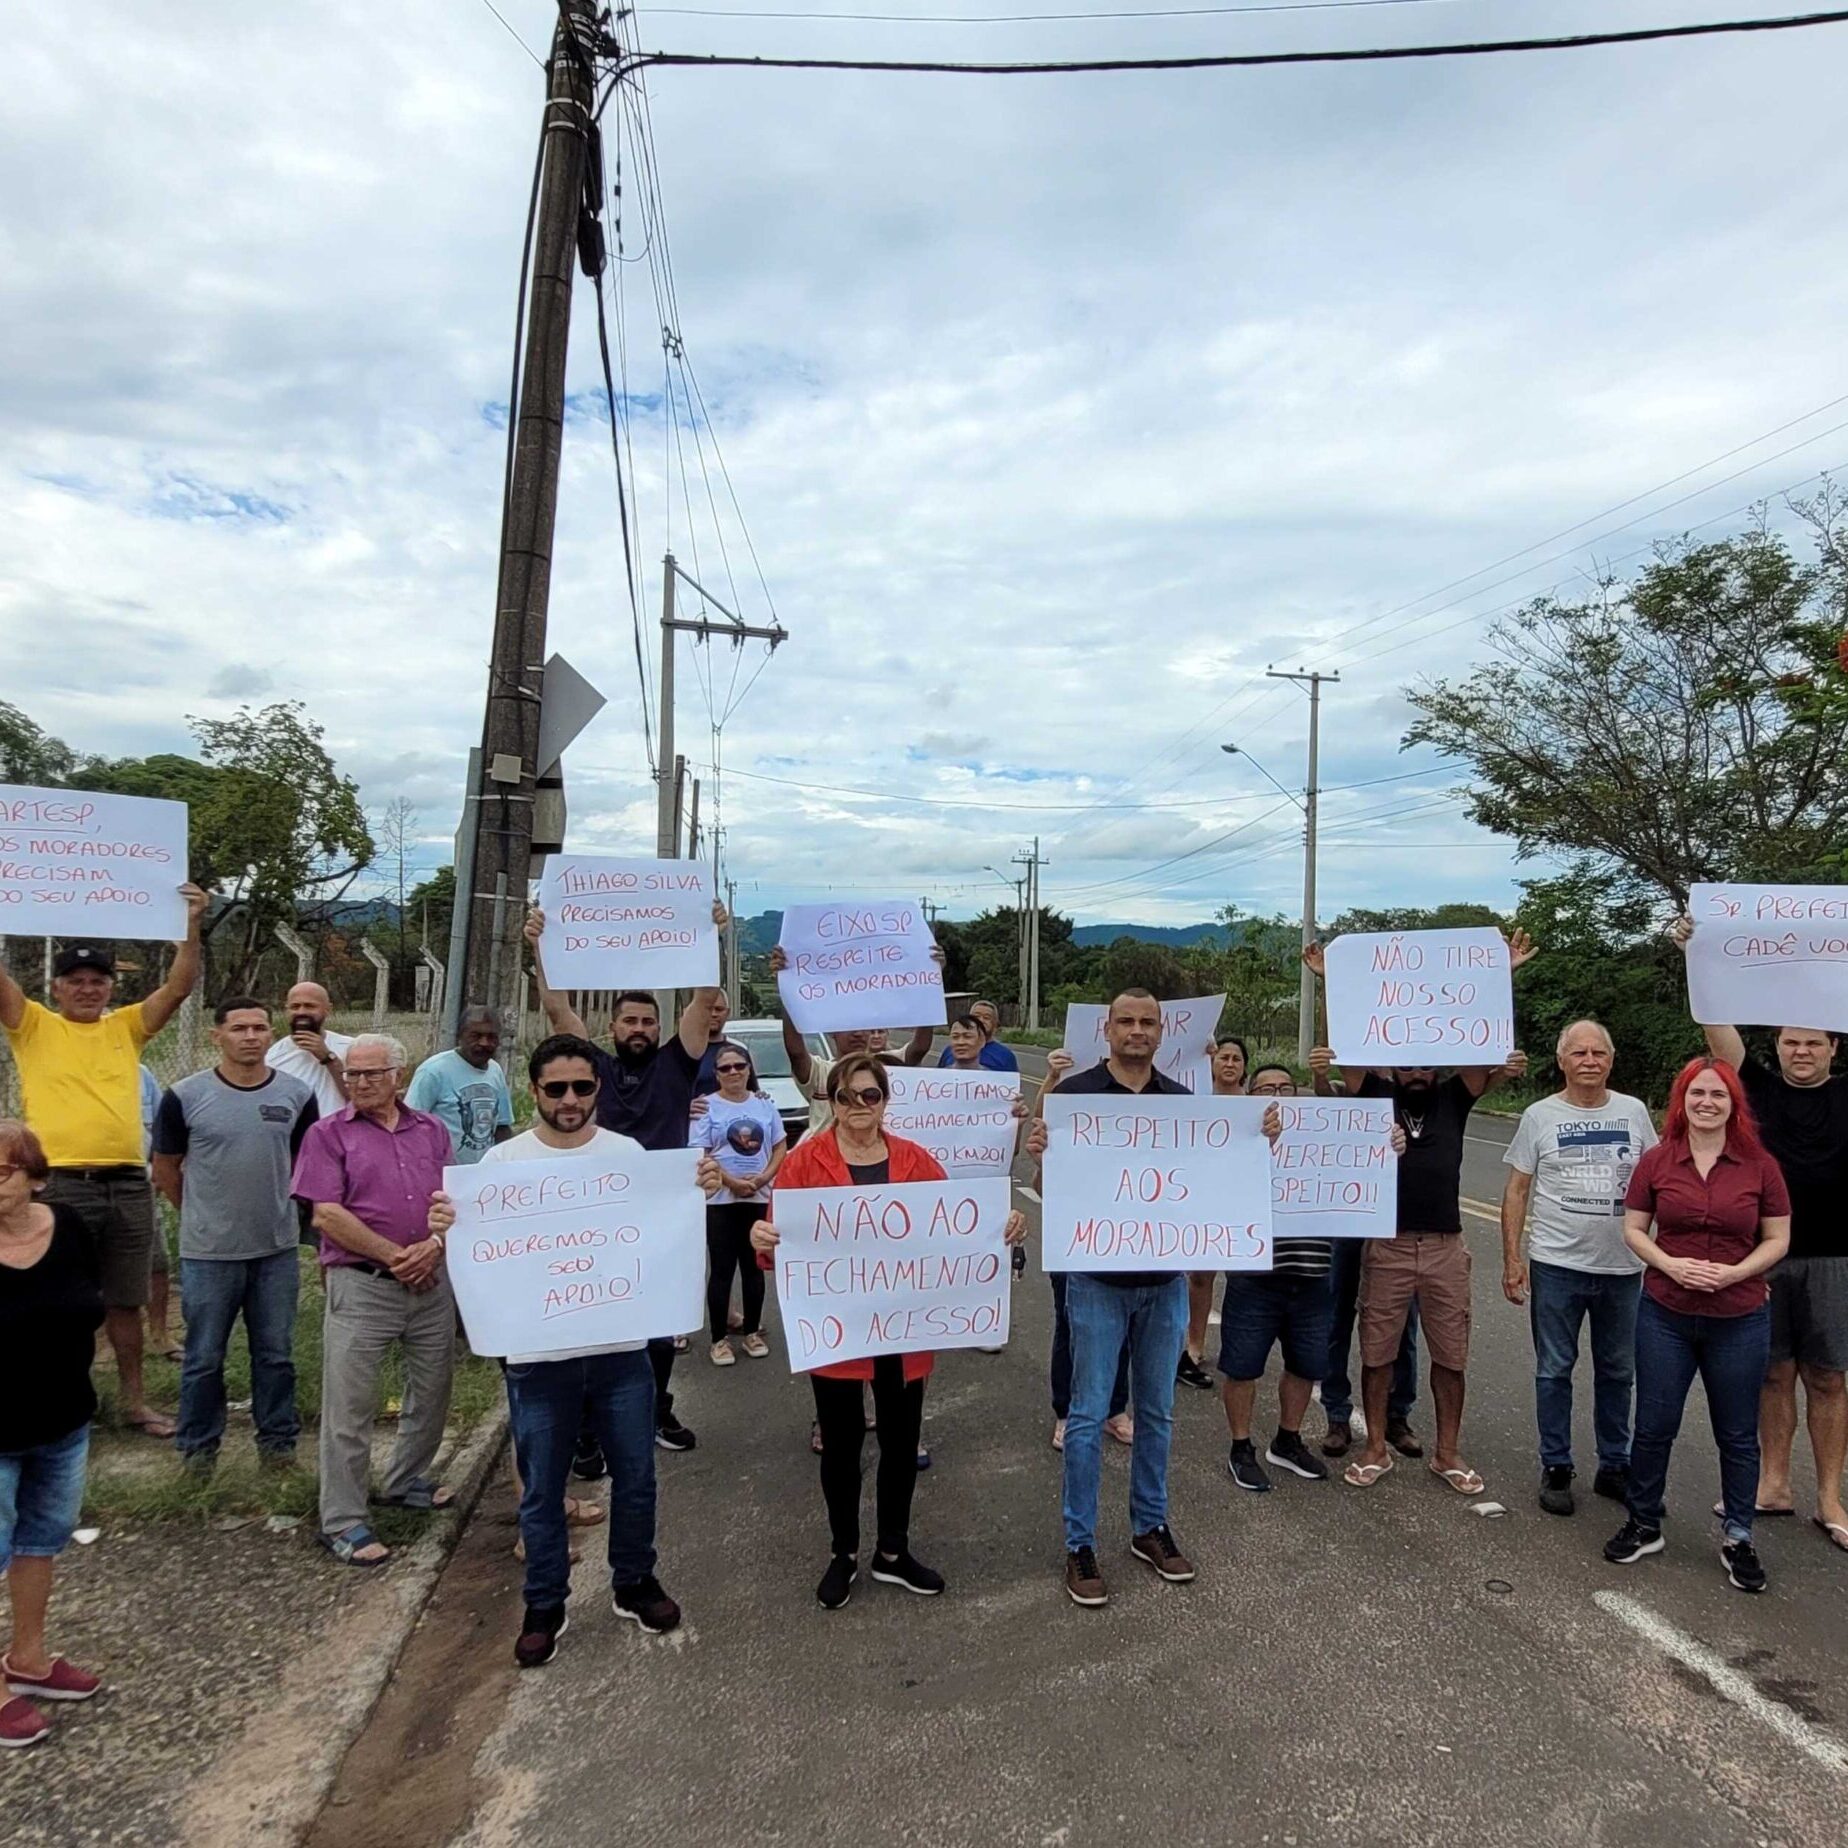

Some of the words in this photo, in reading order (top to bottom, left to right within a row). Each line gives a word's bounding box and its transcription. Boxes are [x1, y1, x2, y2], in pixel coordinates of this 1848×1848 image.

[30, 840, 171, 862] MORADORES
[0, 862, 114, 881] RECISAM
[556, 865, 639, 894] THIAGO
[644, 871, 703, 892] SILVA
[32, 889, 76, 903] SEU
[1756, 894, 1848, 920] PREFEI
[561, 903, 676, 923] PRECISAMOS
[565, 936, 590, 952] DO
[596, 935, 632, 949] SEU
[638, 928, 697, 946] APOIO!
[1371, 935, 1423, 973] NÃO
[1441, 945, 1501, 969] TIRE
[1723, 932, 1798, 957] CADÊ
[796, 945, 904, 976] RESPEITE
[799, 984, 825, 1000] OS
[835, 971, 942, 995] MORADORES
[1377, 980, 1476, 1008] NOSSO
[1362, 1014, 1510, 1049] ACESSO!!
[1068, 1112, 1230, 1149] RESPEITO
[1280, 1105, 1393, 1134] DESTRES
[1556, 1121, 1602, 1132] TOKYO
[473, 1172, 631, 1216] PREFEITO
[1115, 1167, 1188, 1202] AOS
[1271, 1173, 1378, 1209] SPEITO!!
[1561, 1196, 1610, 1205] CONNECTED
[814, 1194, 911, 1241] NÃO
[929, 1197, 979, 1237] AO
[472, 1229, 608, 1263] QUEREMOS
[615, 1225, 640, 1243] O
[1066, 1218, 1265, 1258] MORADORES
[784, 1252, 1000, 1300] FECHAMENTO
[798, 1315, 843, 1357] DO
[866, 1297, 1001, 1345] ACESSO!
